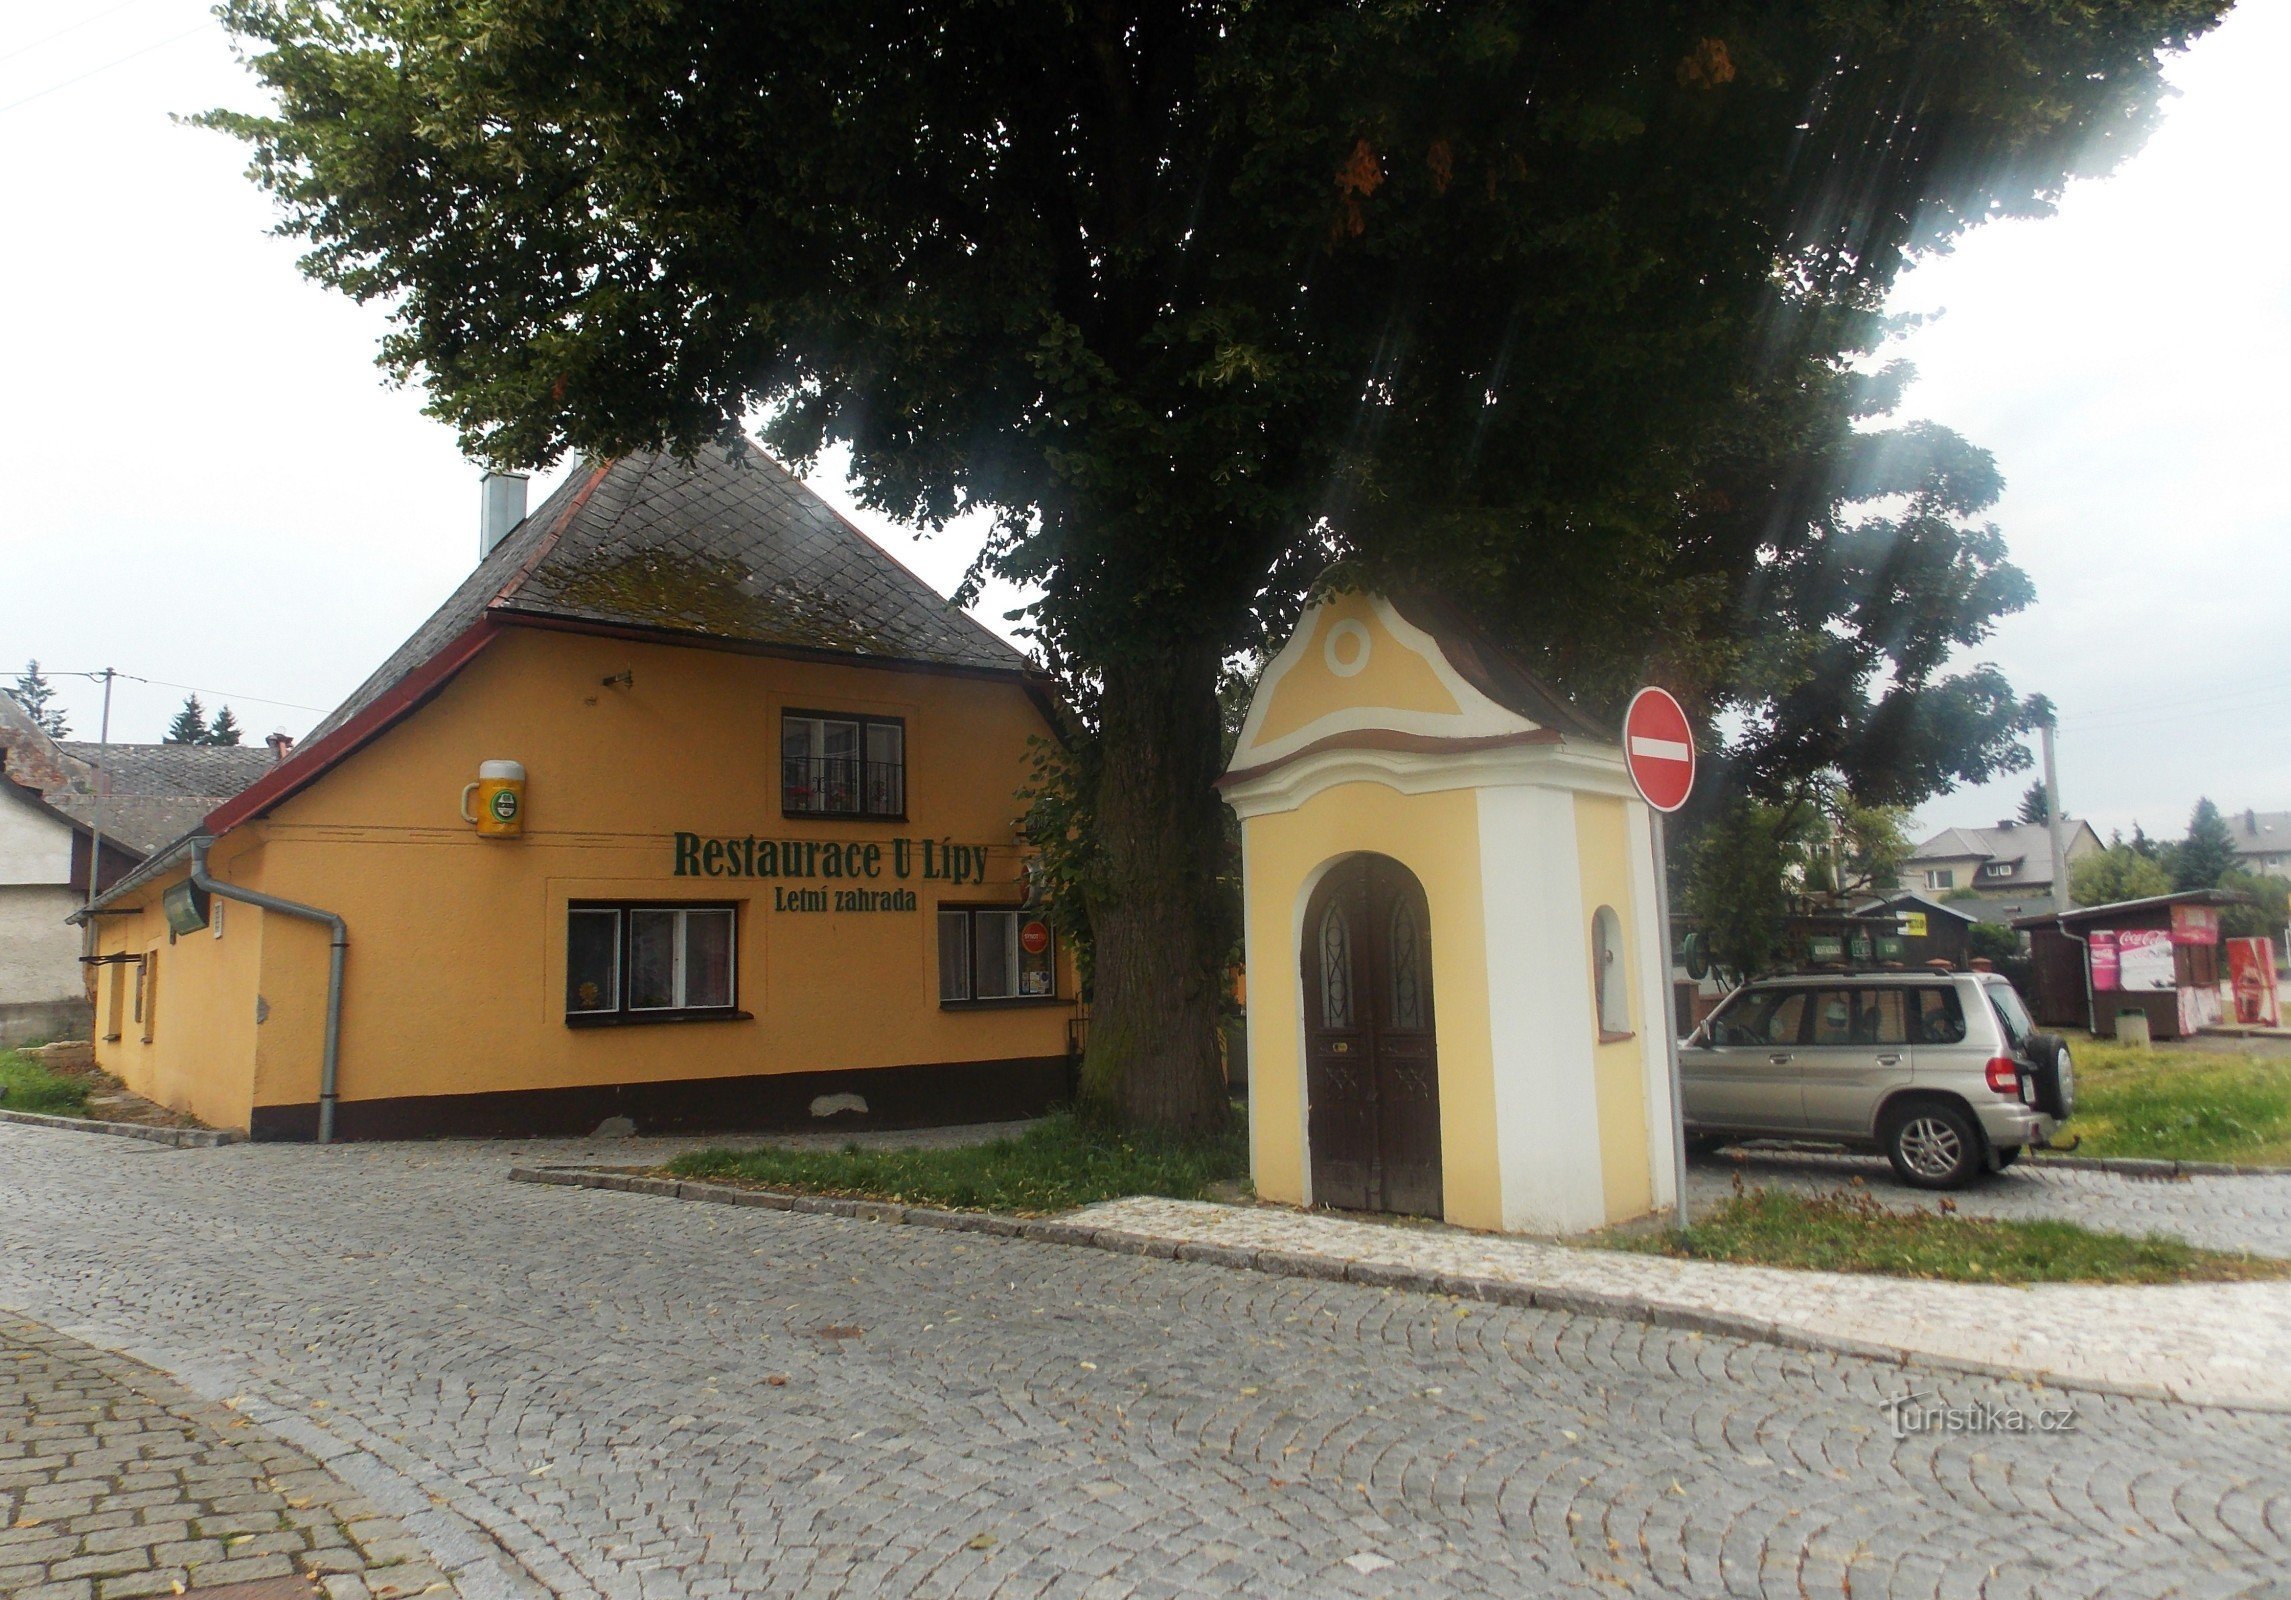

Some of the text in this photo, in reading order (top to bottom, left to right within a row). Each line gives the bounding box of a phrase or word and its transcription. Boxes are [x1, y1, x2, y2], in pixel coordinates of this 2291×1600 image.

[674, 831, 988, 884] Restaurace U Lípy
[774, 885, 917, 912] Letní zahrada
